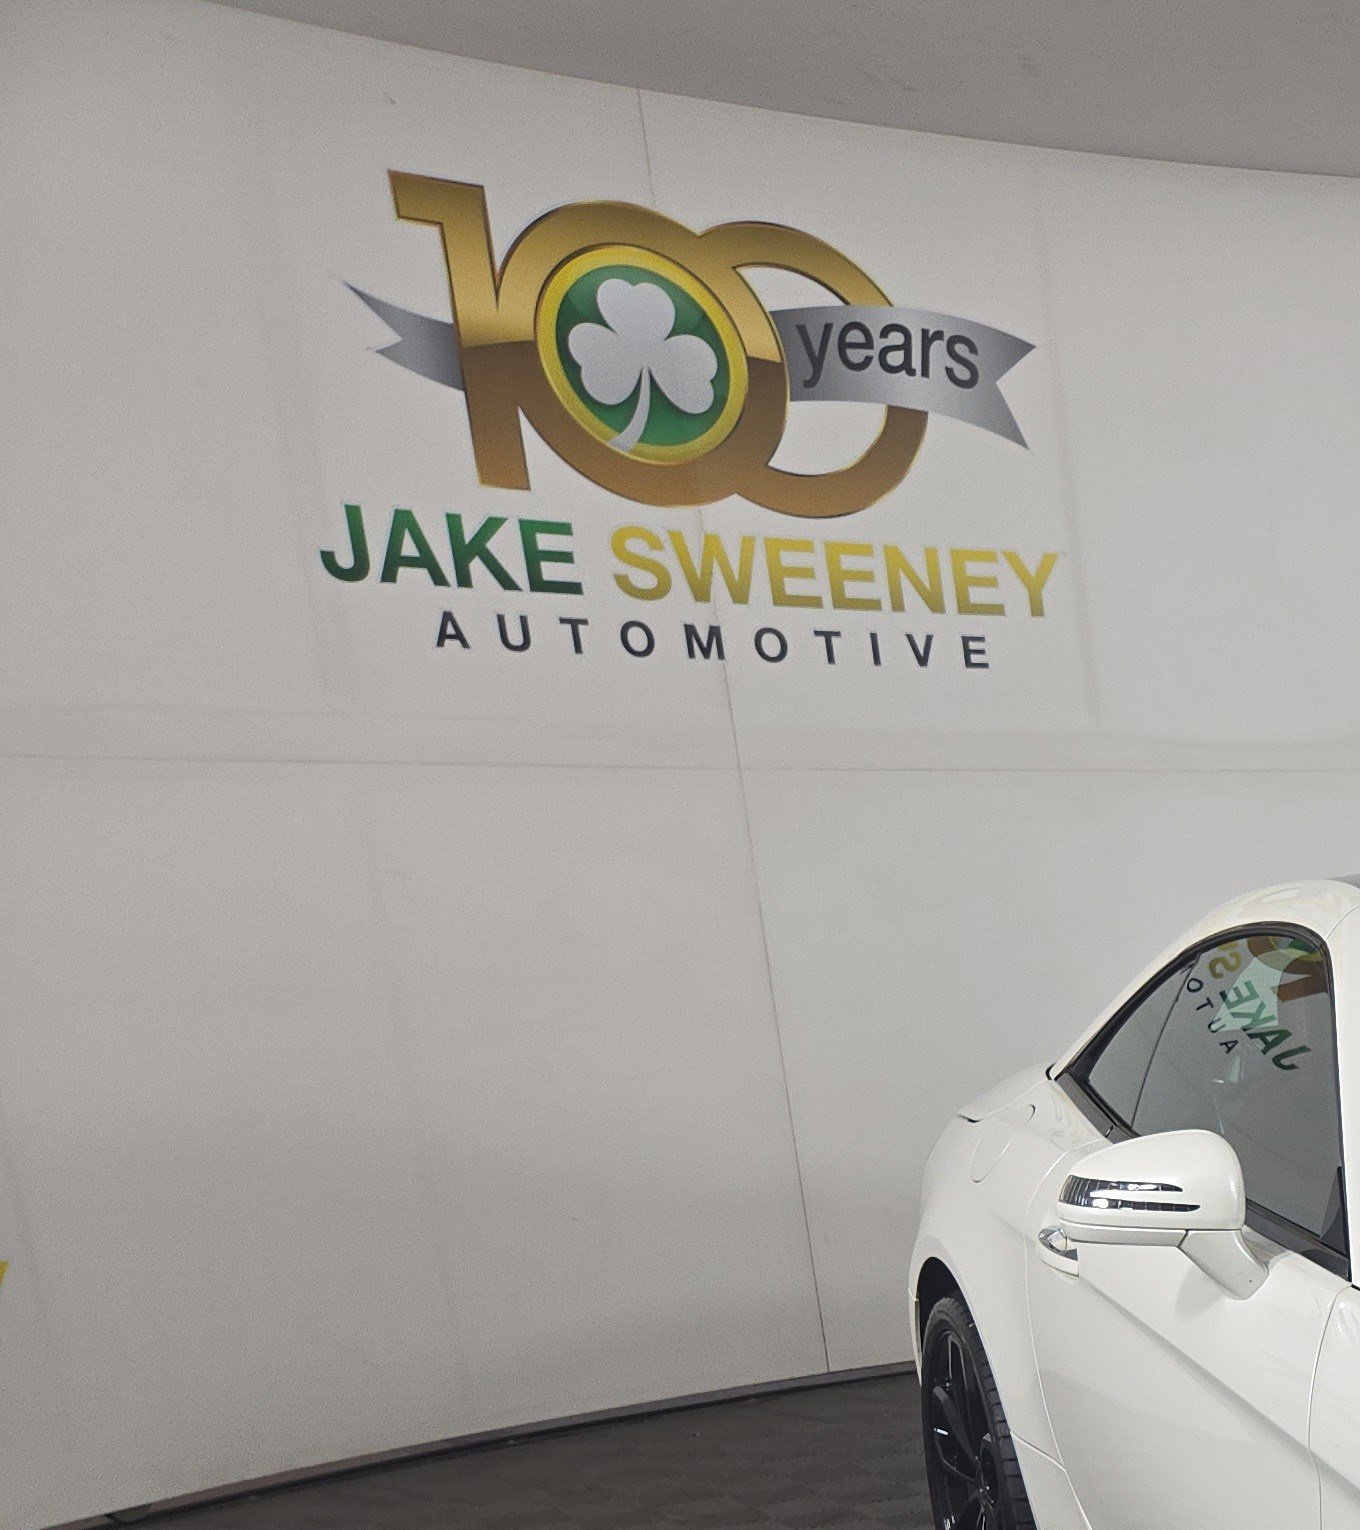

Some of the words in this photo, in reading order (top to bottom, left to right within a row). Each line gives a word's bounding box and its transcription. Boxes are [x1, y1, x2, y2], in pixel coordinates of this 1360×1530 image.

[796, 321, 980, 389] years
[319, 504, 584, 595] JAKE
[608, 525, 1060, 617] SWEENEY
[435, 609, 991, 670] AUTOMOTIVE
